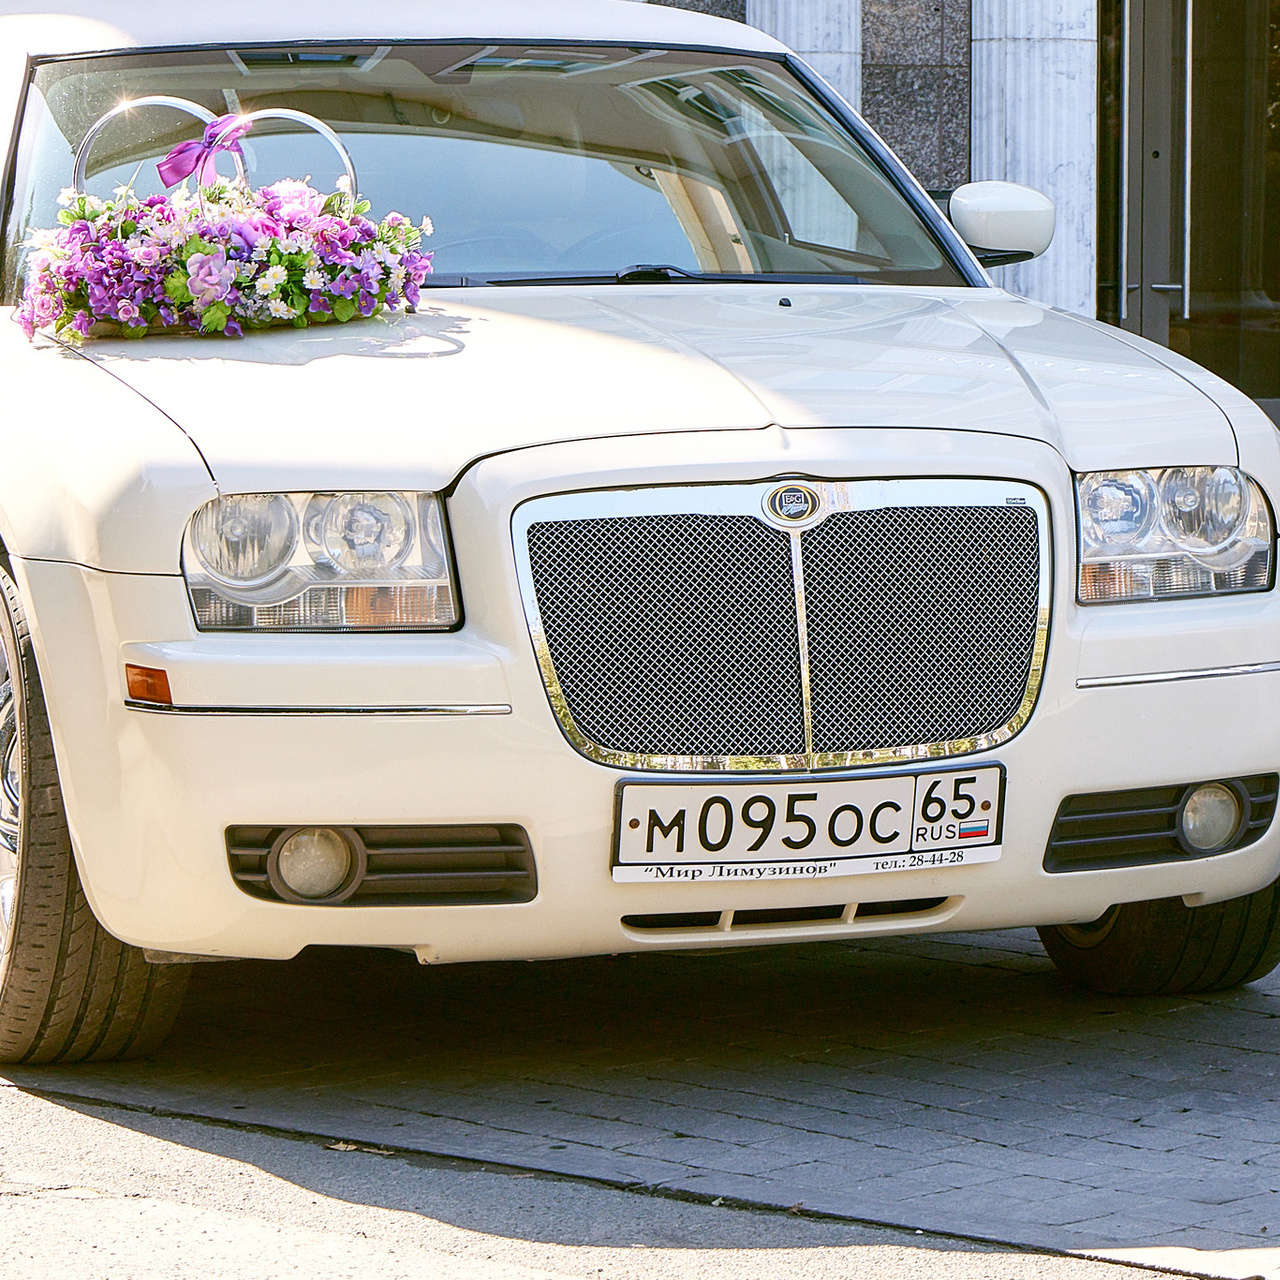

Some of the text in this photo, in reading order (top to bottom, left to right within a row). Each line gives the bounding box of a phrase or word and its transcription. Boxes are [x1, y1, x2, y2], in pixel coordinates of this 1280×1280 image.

[920, 776, 977, 823] 65
[915, 823, 957, 843] RUS
[909, 850, 965, 867] 28-44-28
